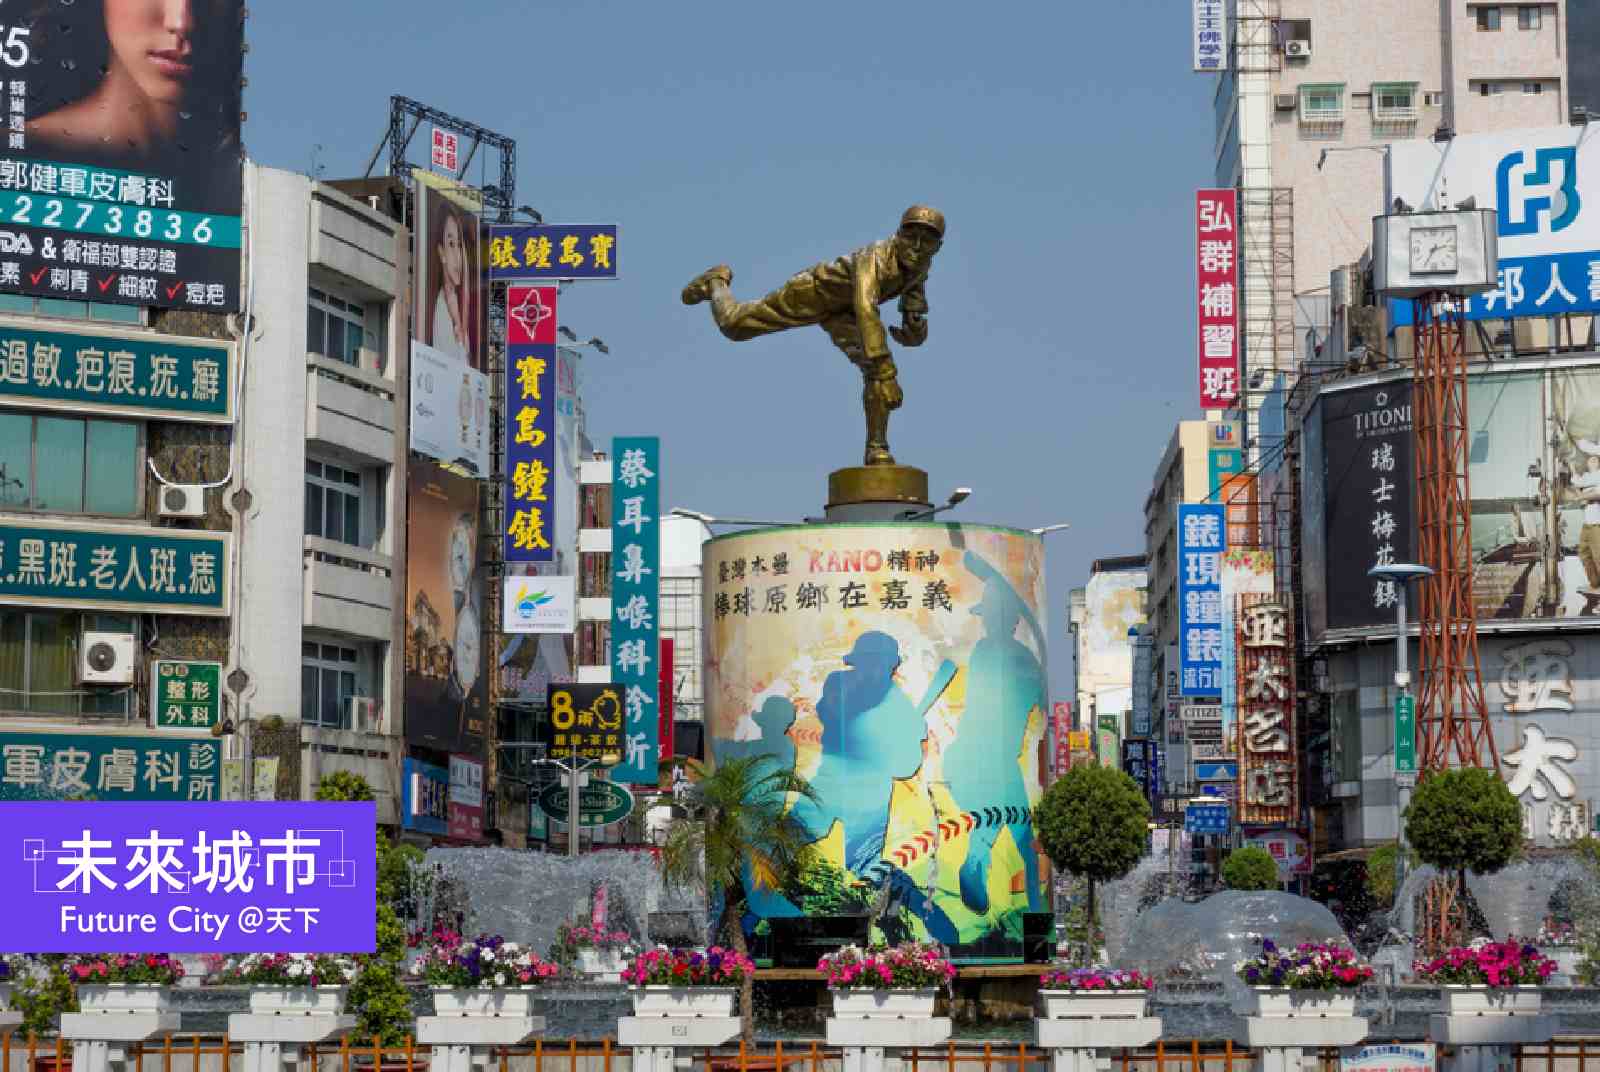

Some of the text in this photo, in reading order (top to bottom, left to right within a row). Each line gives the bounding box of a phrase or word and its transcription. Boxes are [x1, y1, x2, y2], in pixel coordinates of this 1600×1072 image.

[0, 160, 174, 208] 郭健軍皮膚科
[41, 237, 57, 259] &
[50, 268, 89, 293] 刺青
[118, 274, 159, 299] 細紋
[1199, 200, 1236, 400] 弘群補習班
[1354, 404, 1412, 431] TITONI
[508, 355, 551, 550] 寶島鐘錶
[714, 579, 954, 620] 棒球原鄉在嘉義
[167, 680, 210, 701] 整形
[166, 704, 210, 726] 外科
[2, 744, 182, 792] 軍皮膚科
[188, 744, 215, 801] 診所
